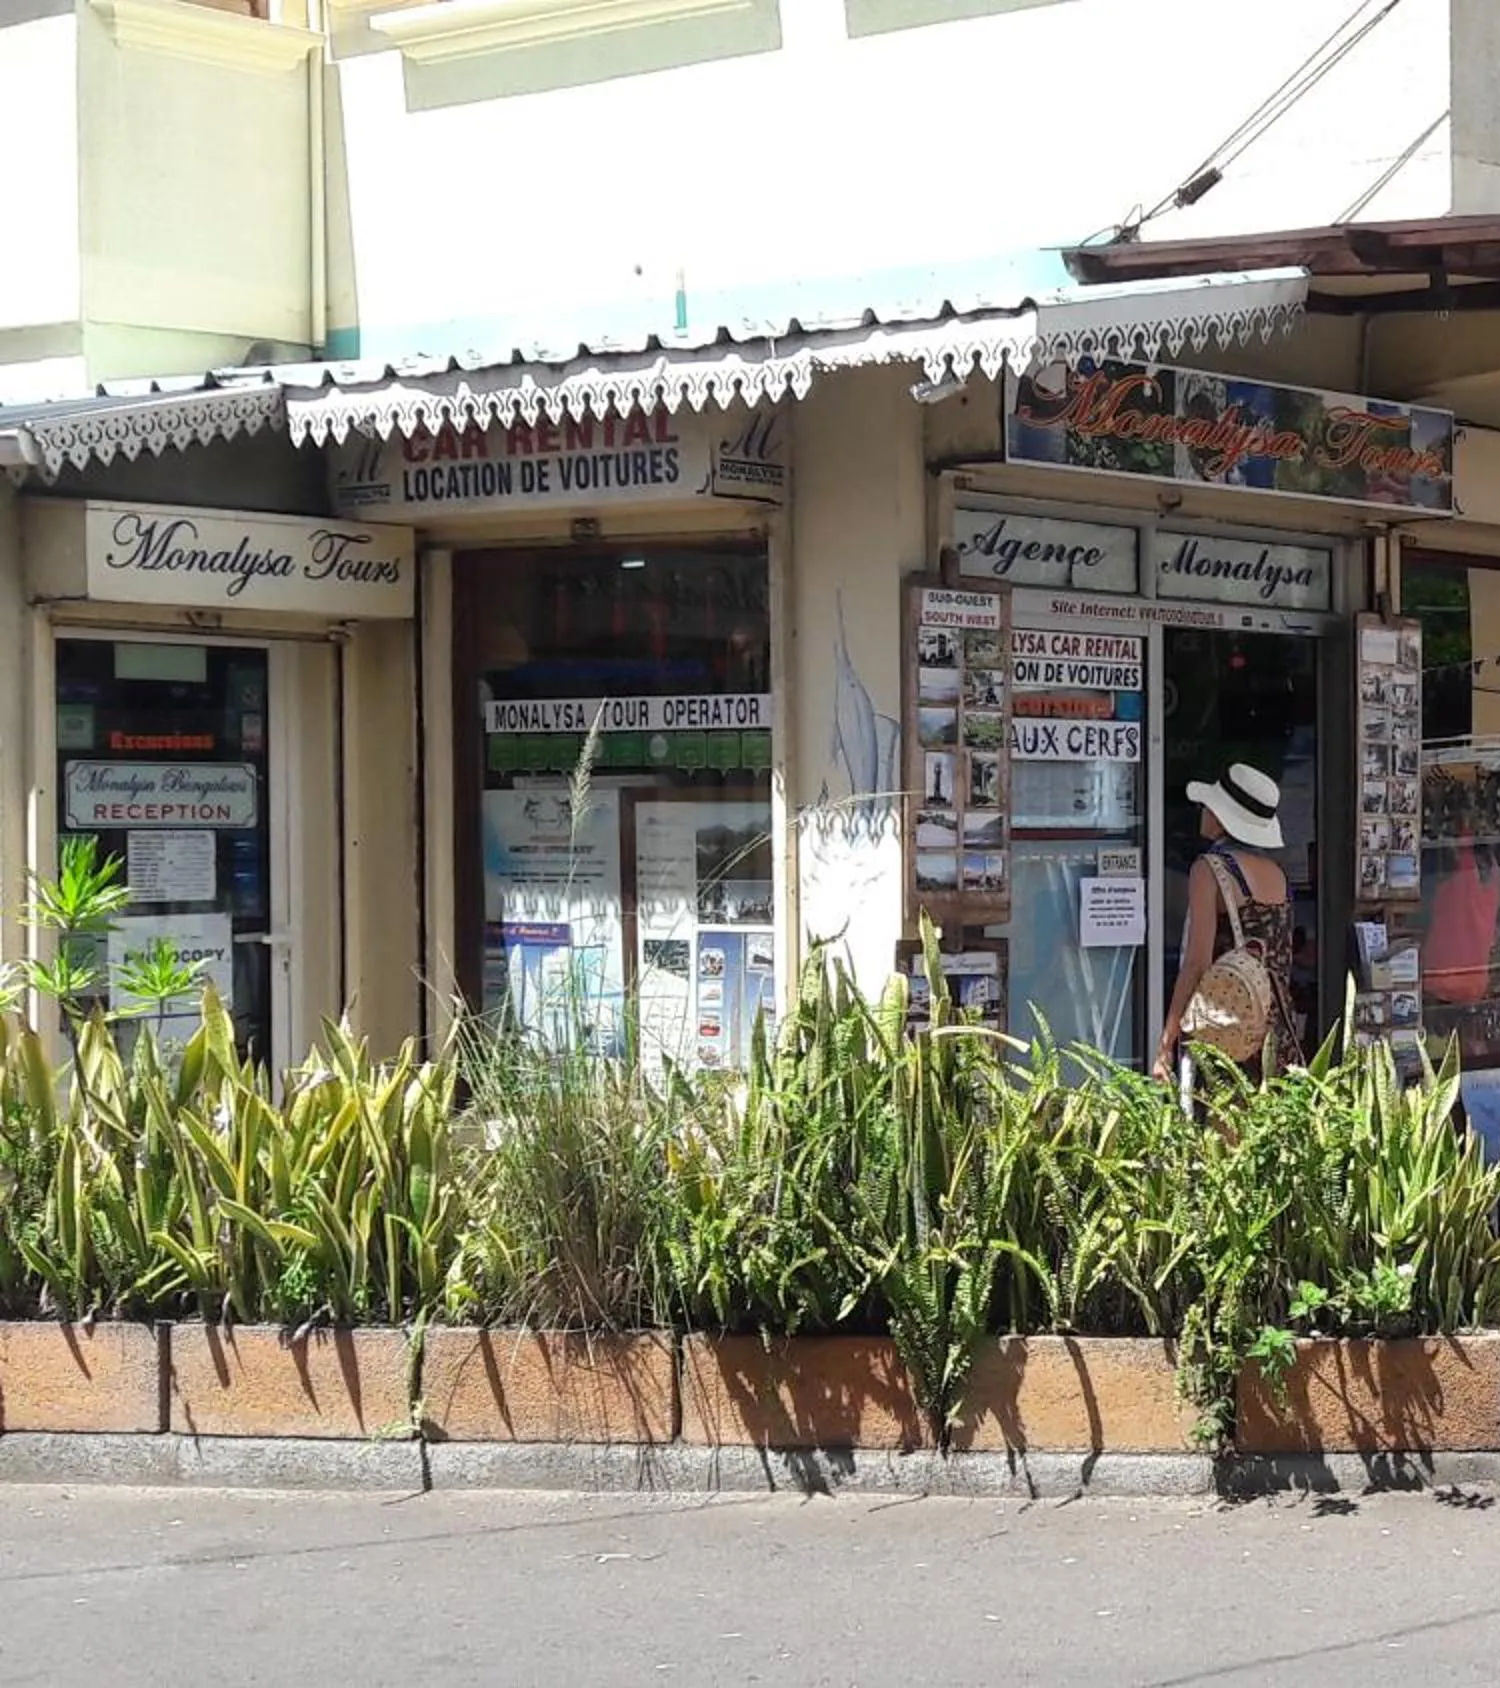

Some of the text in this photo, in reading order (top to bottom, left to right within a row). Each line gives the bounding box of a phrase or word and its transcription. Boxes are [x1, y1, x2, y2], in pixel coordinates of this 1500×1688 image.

[507, 402, 679, 456] RENTAL
[1018, 366, 1447, 478] Monalysa Tours
[403, 462, 513, 501] LOCATION
[521, 459, 550, 494] DE
[558, 448, 680, 491] VOITURES
[106, 513, 400, 597] Monalysa Tours
[957, 519, 1314, 599] Agence Monalysa
[924, 610, 997, 627] SOUTH WEST
[1051, 600, 1076, 614] Site
[1051, 635, 1081, 657] CAR
[1085, 637, 1138, 660] RENTAL
[1044, 662, 1064, 683] DE
[1067, 663, 1139, 688] VOITURES
[494, 696, 761, 730] MONALYSA TOUR OPERATOR
[1067, 724, 1139, 758] CERFS
[94, 803, 232, 820] RECEPTION
